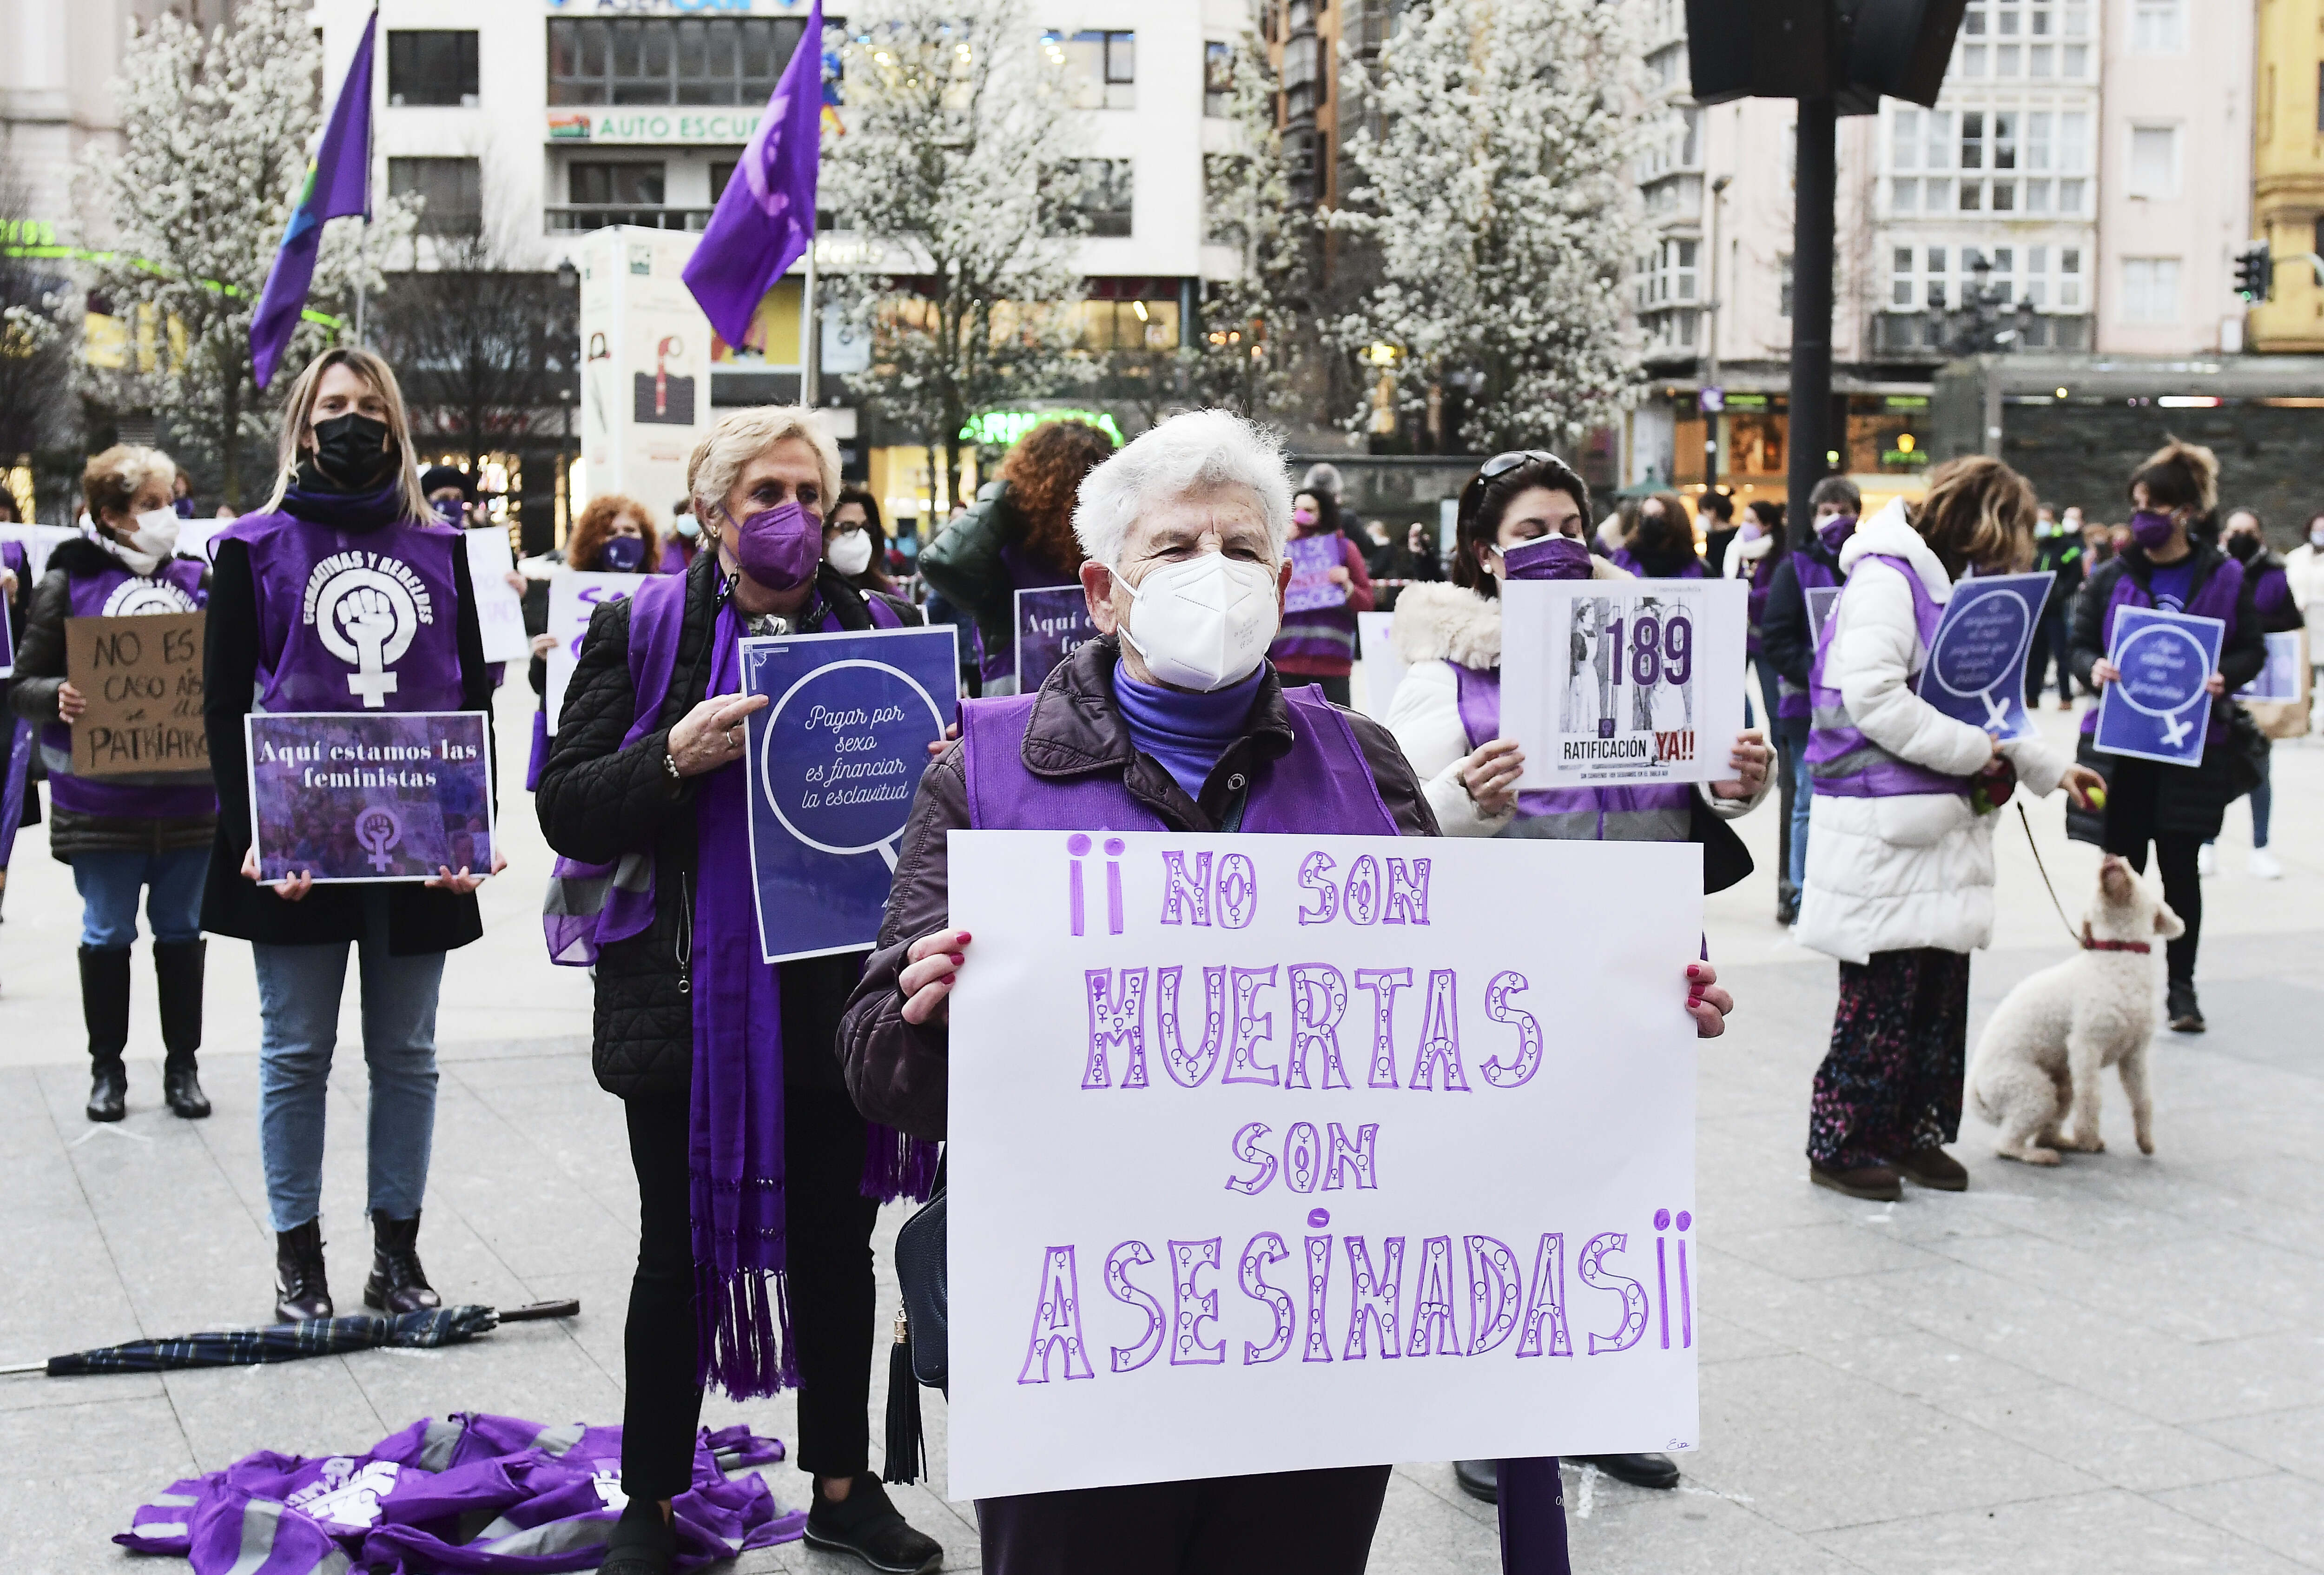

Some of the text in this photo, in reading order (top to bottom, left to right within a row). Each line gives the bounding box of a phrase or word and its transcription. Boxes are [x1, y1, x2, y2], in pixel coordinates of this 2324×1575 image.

[599, 116, 670, 137] AUTO
[367, 551, 378, 568] Y
[1026, 612, 1077, 638] Aquí
[92, 629, 195, 668] NO ES
[1605, 616, 1692, 685] 189
[104, 675, 165, 703] CASO
[805, 705, 905, 734] Pagar por
[259, 739, 477, 768] Aquí estamos las
[835, 735, 878, 753] sexo
[1564, 731, 1694, 761] RATIFICACIÓN YA!!
[304, 768, 437, 788] feministas
[805, 757, 907, 788] es financiar
[801, 781, 909, 809] la esclavitud
[1161, 850, 1258, 930] NO
[1298, 850, 1433, 926] SON
[1081, 962, 1544, 1092] MUERTAS
[1224, 1121, 1380, 1196] SON
